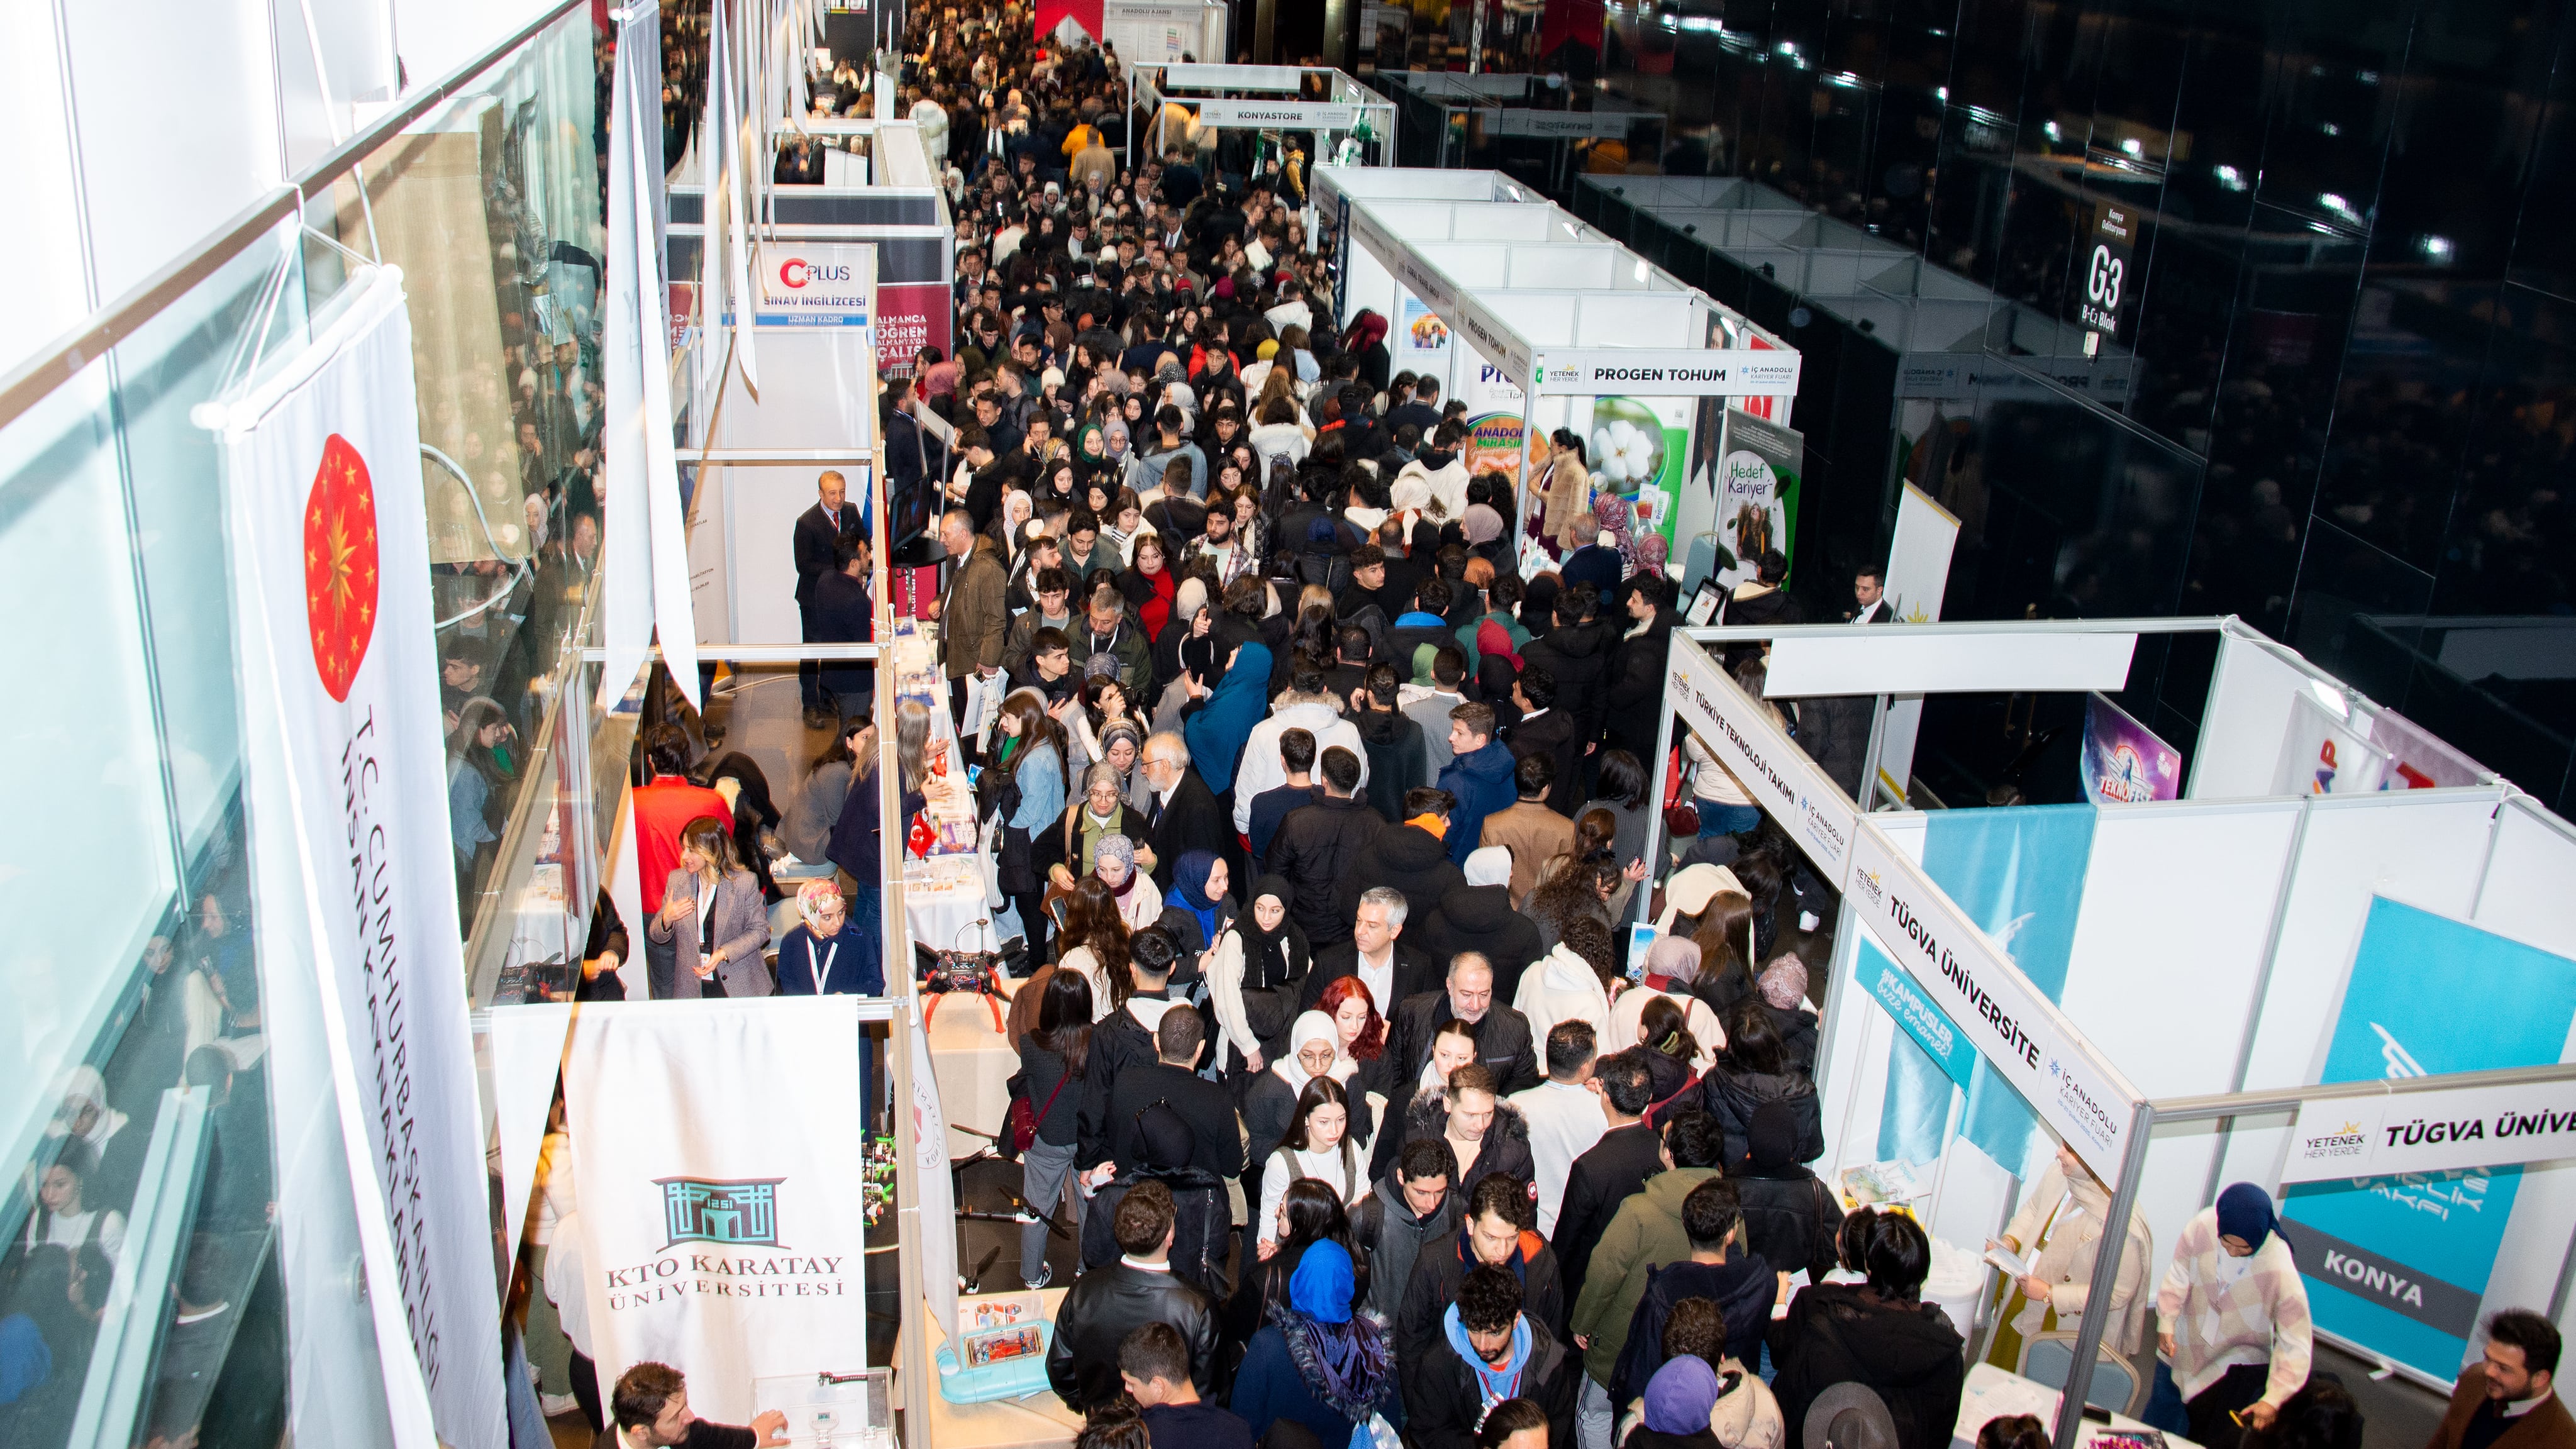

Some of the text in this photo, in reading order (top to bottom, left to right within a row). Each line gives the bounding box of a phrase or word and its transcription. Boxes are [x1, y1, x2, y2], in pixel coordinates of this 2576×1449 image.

[1238, 111, 1303, 121] KONYASTORE
[2101, 219, 2127, 237] Oditoryum
[2109, 208, 2124, 223] Konya
[1416, 274, 1429, 291] TRAVEL
[2089, 244, 2123, 309] G3
[763, 294, 866, 307] SINAV İNGİLİZCESİ
[877, 314, 927, 324] ALMANCA
[877, 325, 927, 338] ÖĞREN
[2098, 311, 2116, 332] Blok
[1468, 316, 1506, 359] PROGEN TOHUM
[1594, 368, 1726, 381] PROGEN TOHUM
[1751, 365, 1758, 374] İÇ
[1474, 426, 1534, 438] ANADOL
[1731, 461, 1765, 479] Hedef
[1728, 477, 1768, 499] Kariyer
[1672, 670, 1690, 694] YETENEK
[1696, 690, 1725, 730] TÜRKİYE
[1726, 722, 1767, 775] TEKNOLOJİ
[1768, 767, 1795, 805] TAKIMI
[1807, 816, 1841, 858] KARİYER FUARI
[1809, 801, 1844, 846] İÇ ANADOLU
[1856, 877, 1881, 909] HER YERDE
[1857, 865, 1882, 899] YETENEK
[1877, 976, 1902, 1011] bize
[1890, 894, 2040, 1071] TÜGVA ÜNİVERSİTE
[357, 704, 440, 1392] T.C. CUMHURBAŞKANLIĞI
[2062, 1069, 2117, 1135] İÇ ANADOLU
[364, 945, 409, 1301] KAYNAKLARI
[2059, 1085, 2112, 1148] KARİYER FUARI
[2385, 1108, 2576, 1147] TÜGVA ÜNİVE
[2304, 1145, 2363, 1159] HER YERDE
[2306, 1134, 2366, 1148] YETENEK
[708, 1199, 733, 1209] 1251
[605, 1254, 844, 1289] KTO KARATAY
[2323, 1248, 2423, 1308] KONYA
[608, 1278, 845, 1311] ÜNİVERSİTESİ
